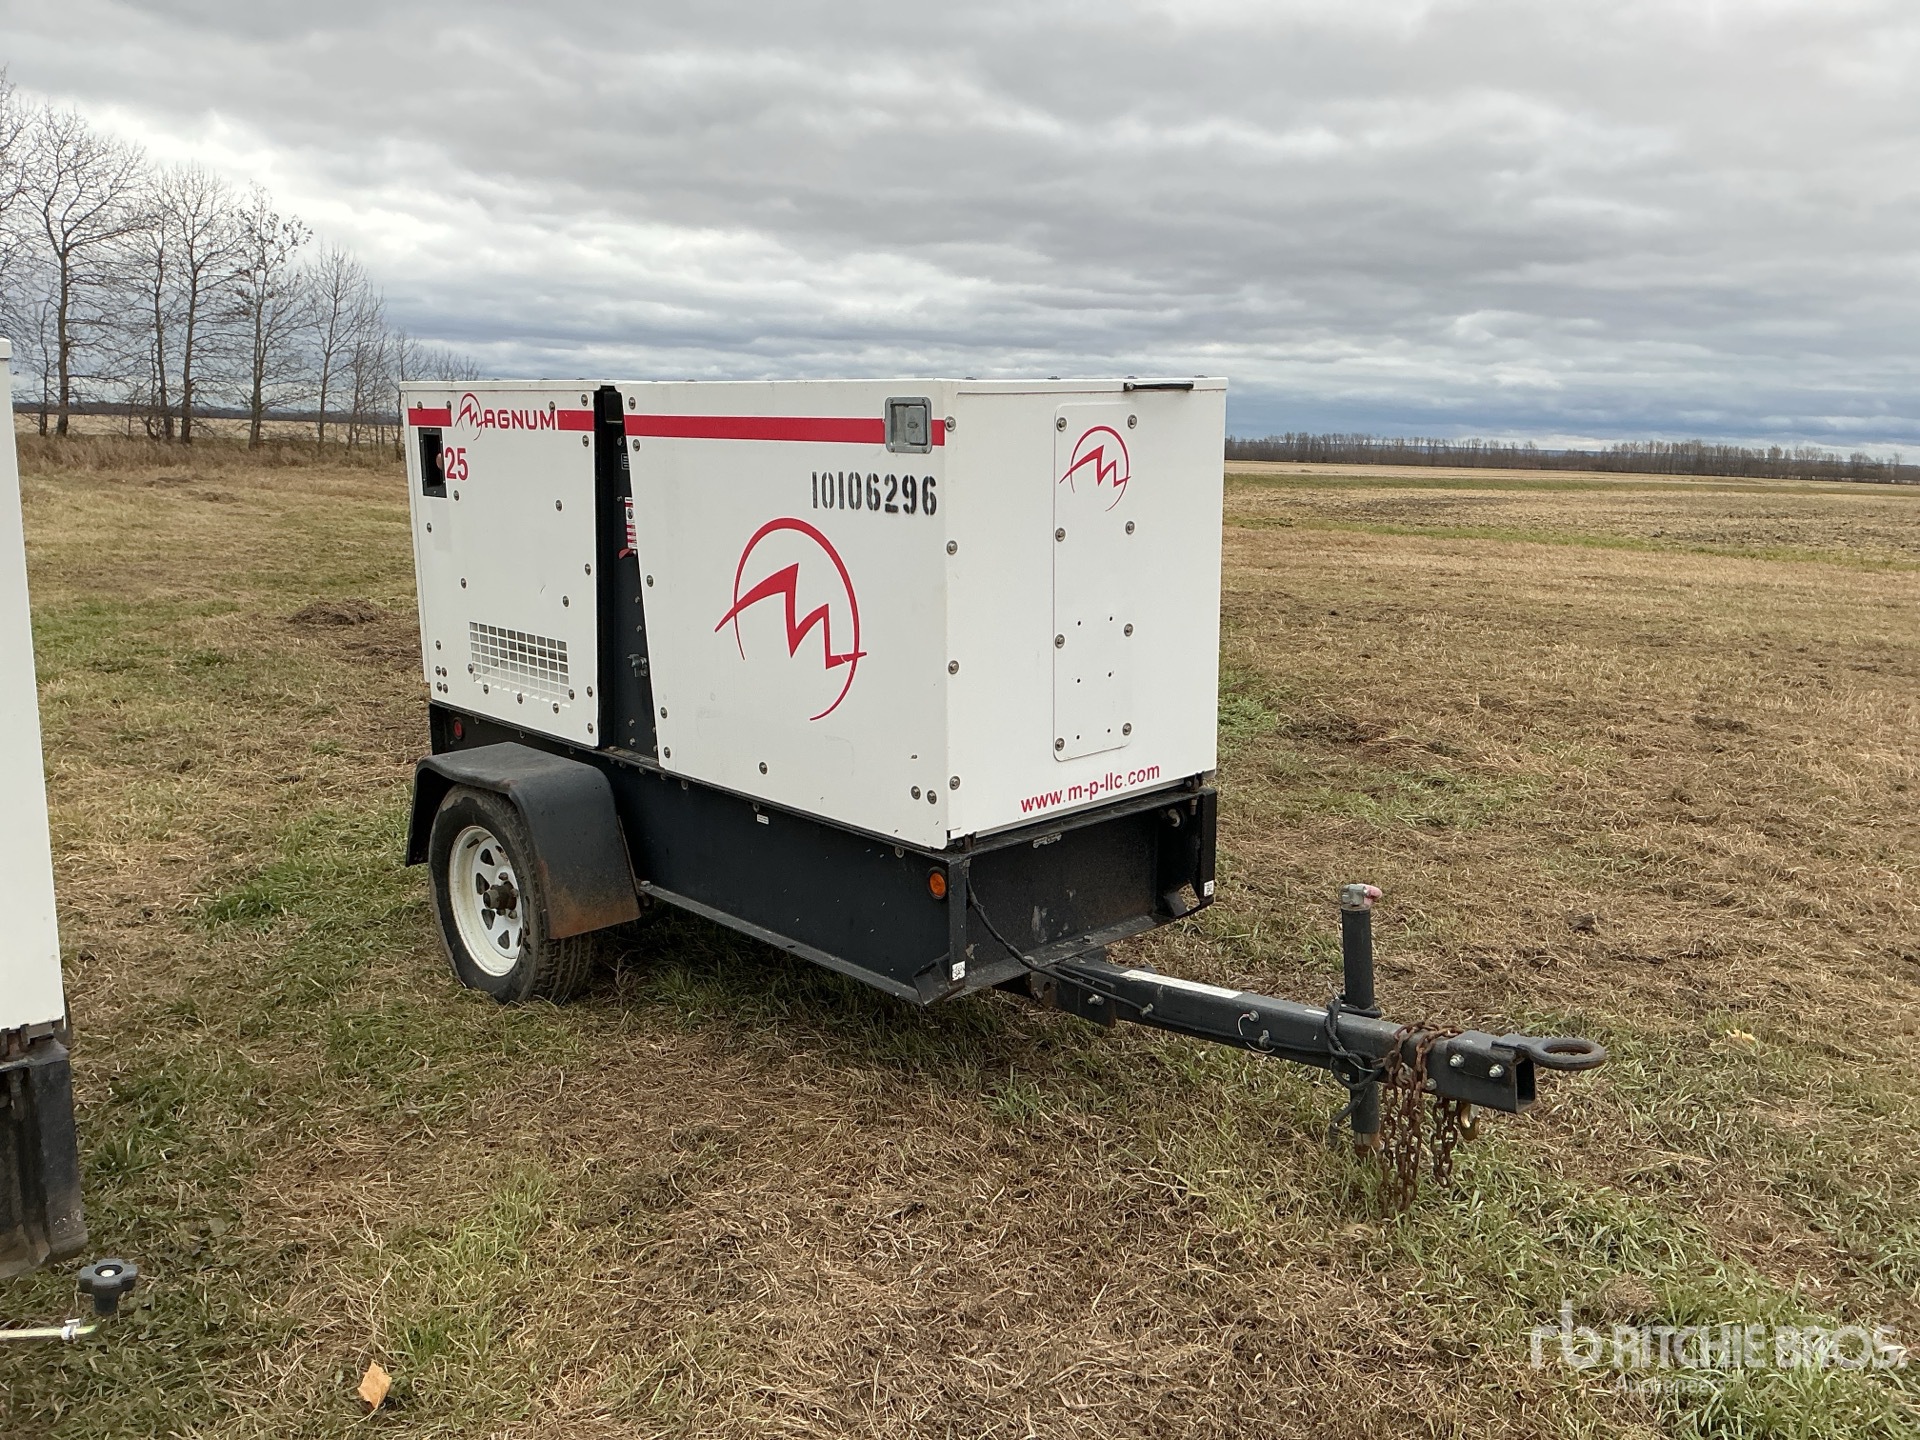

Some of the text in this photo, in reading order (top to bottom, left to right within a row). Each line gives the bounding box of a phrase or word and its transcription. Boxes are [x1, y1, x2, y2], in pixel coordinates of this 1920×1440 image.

[455, 393, 556, 438] MAGNUM
[445, 447, 469, 480] 25
[812, 471, 937, 516] 10106296
[1020, 765, 1160, 813] www.m-p-llc.com
